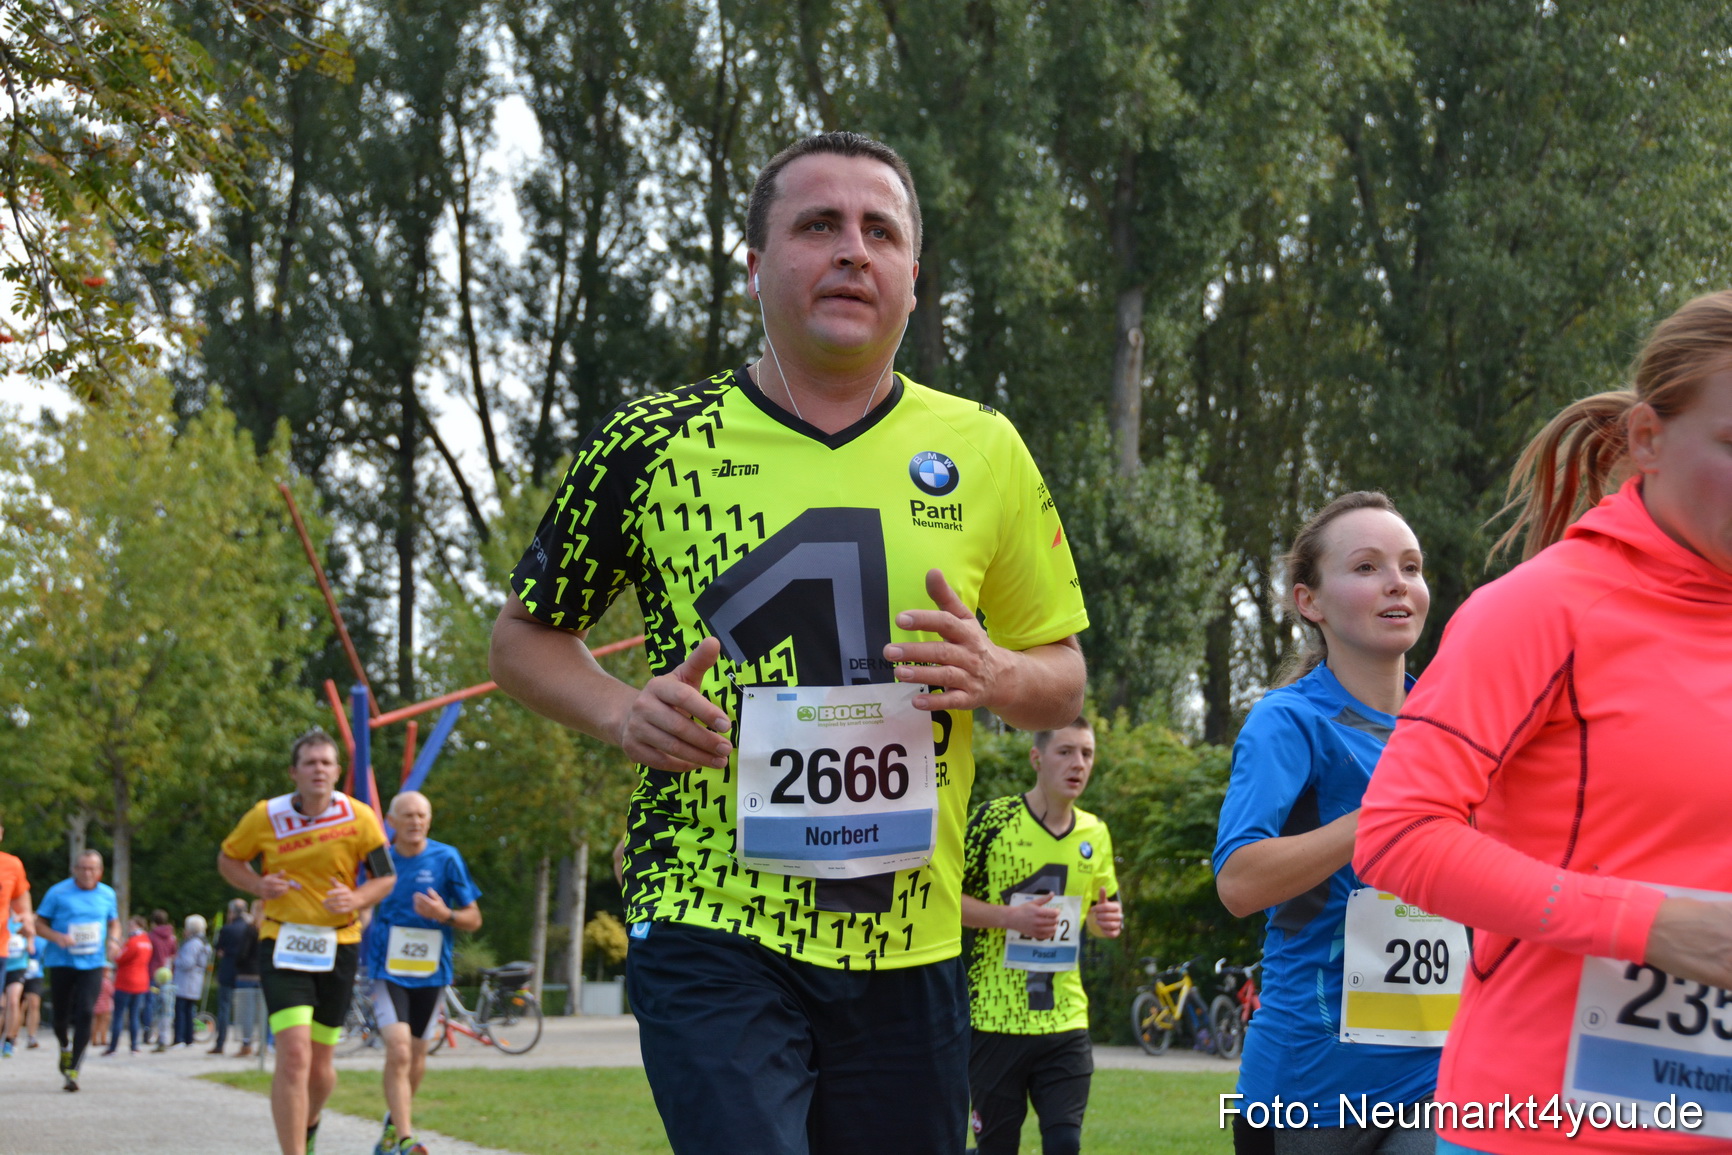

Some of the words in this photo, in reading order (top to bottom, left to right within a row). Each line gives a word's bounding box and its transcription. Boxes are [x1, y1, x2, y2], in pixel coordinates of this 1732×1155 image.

[913, 452, 954, 469] BMW
[910, 499, 962, 522] Partl
[913, 517, 963, 532] Neumarkt
[849, 658, 875, 670] DER
[818, 703, 883, 721] BOCK
[769, 743, 909, 804] 2666
[750, 798, 757, 808] D
[805, 824, 879, 846] Norbert
[286, 935, 327, 954] 2608
[401, 942, 429, 958] 429
[1384, 939, 1450, 985] 289
[1353, 975, 1359, 985] D
[1589, 1012, 1599, 1025] D
